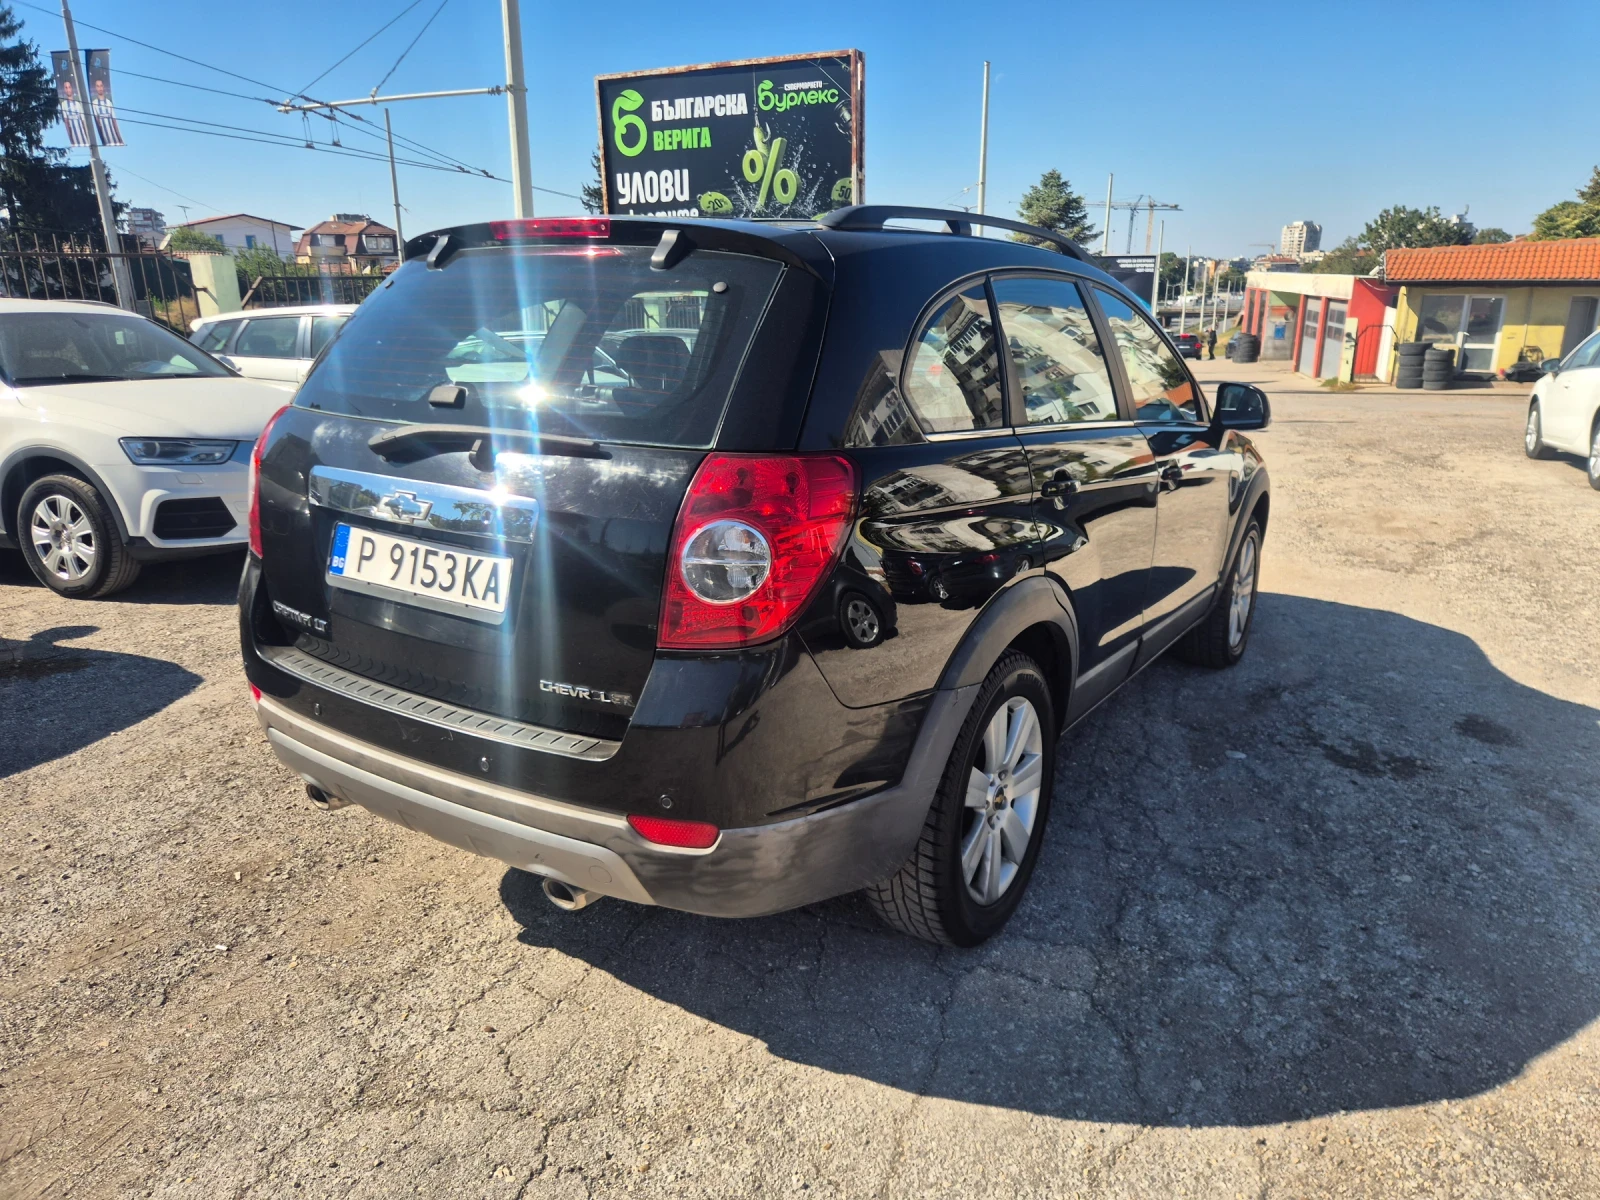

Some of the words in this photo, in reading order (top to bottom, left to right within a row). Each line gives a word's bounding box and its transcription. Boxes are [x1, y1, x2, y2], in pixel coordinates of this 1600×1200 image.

[651, 93, 748, 122] БЪЛГАРСКА
[653, 127, 712, 151] ВЕРИГА
[616, 168, 690, 205] УЛОВИ
[331, 556, 346, 569] BG
[357, 535, 376, 574] P
